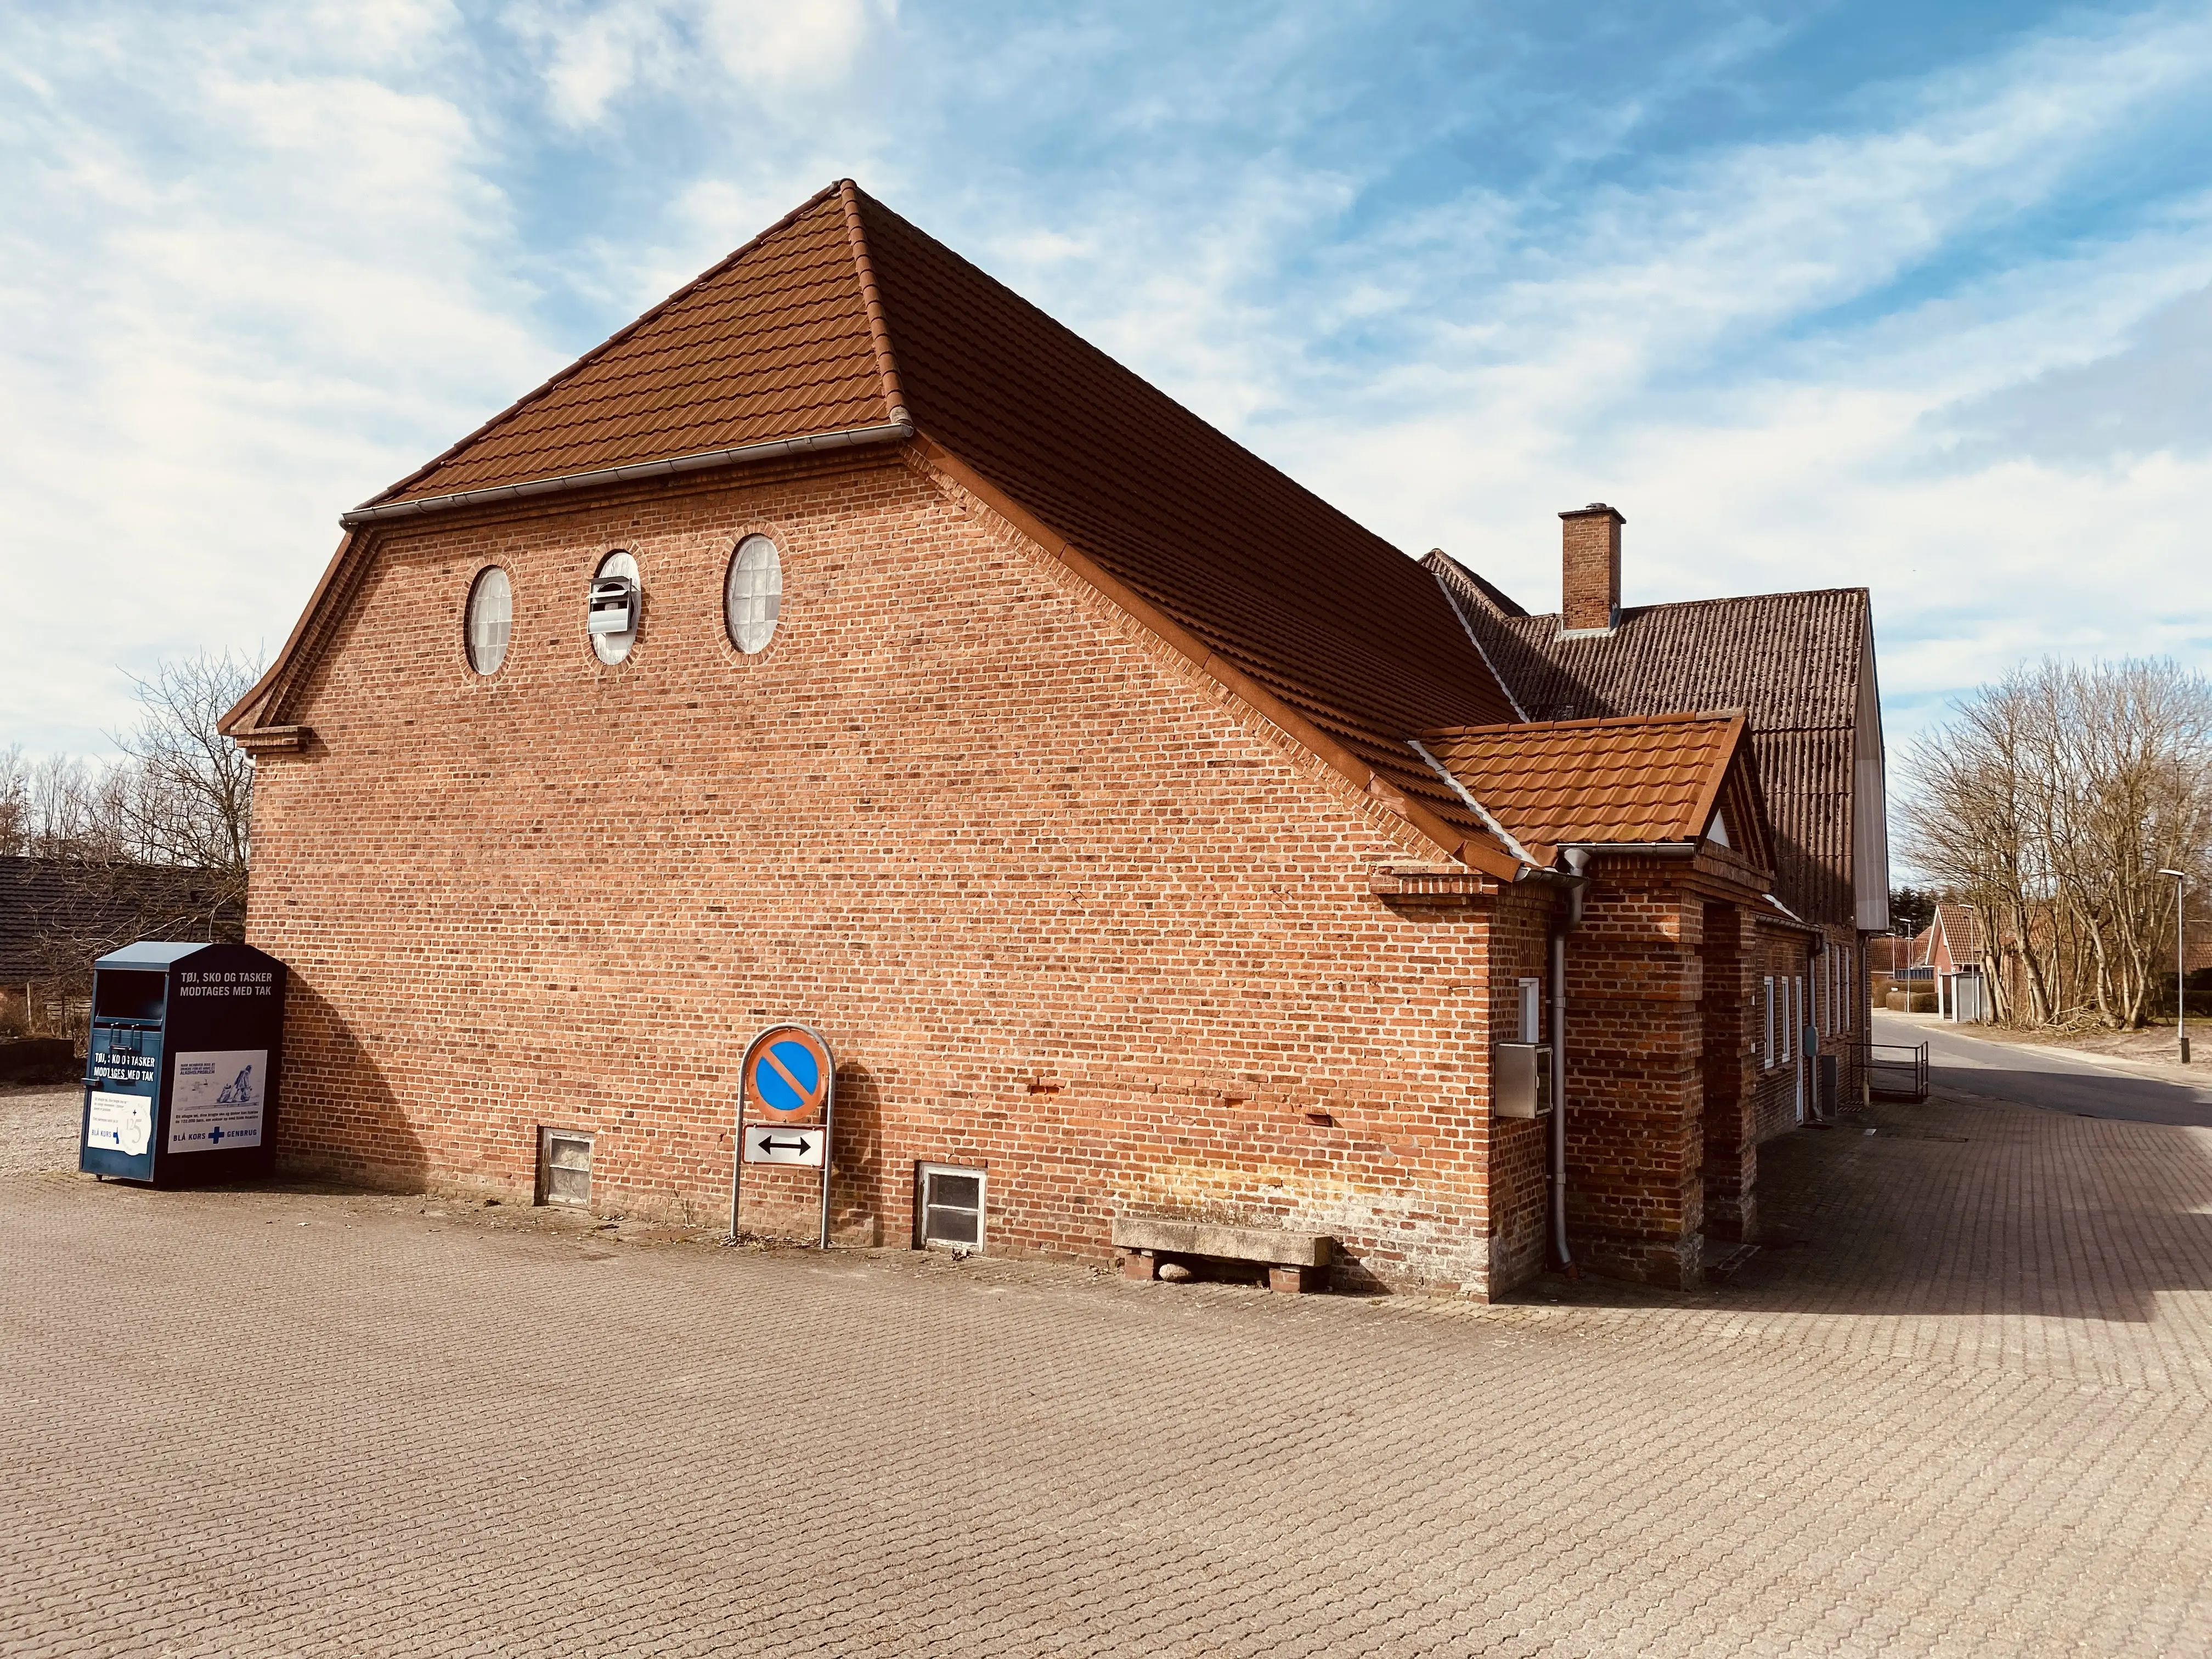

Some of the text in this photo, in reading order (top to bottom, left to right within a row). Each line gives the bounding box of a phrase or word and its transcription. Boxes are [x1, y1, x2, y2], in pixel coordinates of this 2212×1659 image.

[181, 972, 272, 984] TØJ, SKO OG TASKER
[180, 986, 271, 996] MODTAGES MED TAK
[95, 1052, 106, 1064] TØJ,
[131, 1056, 155, 1067] TASKER
[142, 1071, 154, 1081] TAK
[173, 1132, 185, 1142] BLÅ
[227, 1129, 257, 1137] GENBRUG
